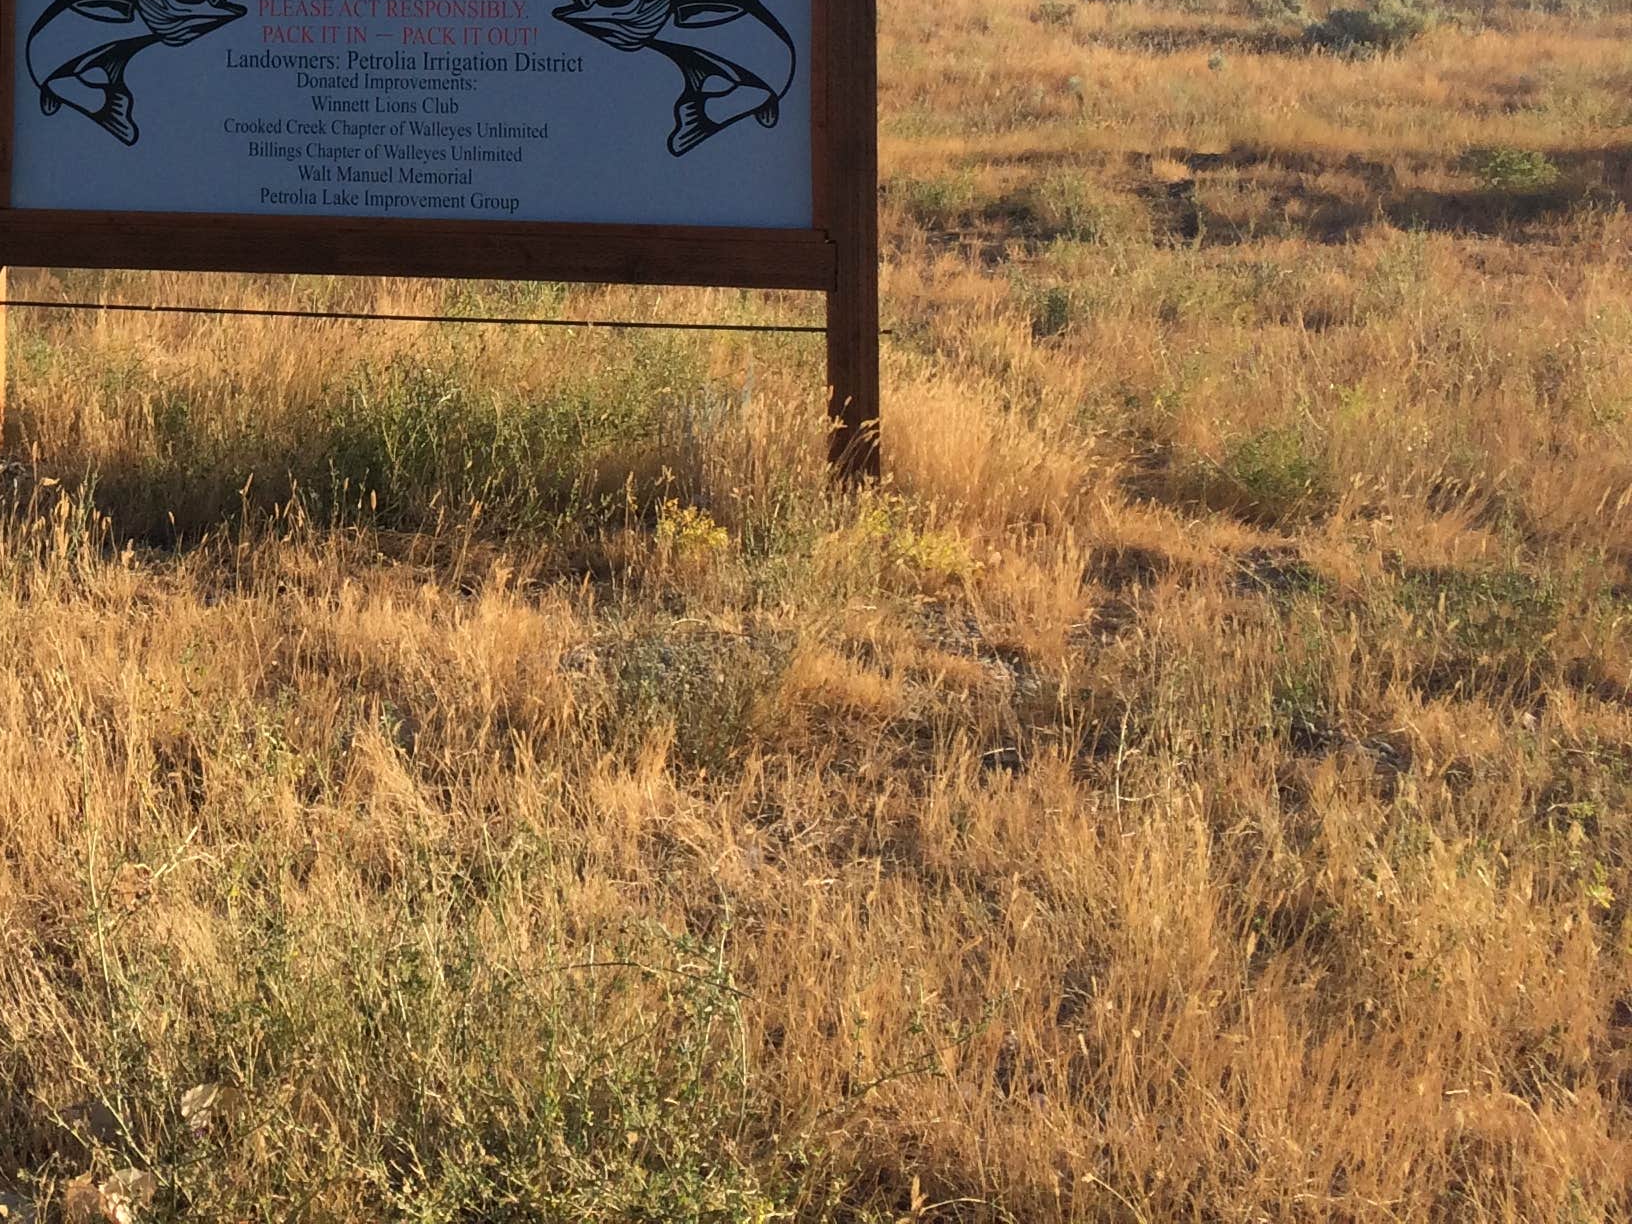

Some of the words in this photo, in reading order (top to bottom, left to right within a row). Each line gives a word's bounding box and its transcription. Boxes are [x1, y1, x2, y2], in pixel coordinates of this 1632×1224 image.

[258, 0, 333, 17] PLEASE
[339, 0, 382, 17] ACT
[386, 0, 528, 19] RESPONSIBLY.
[262, 25, 314, 43] PACK
[322, 25, 341, 44] IT
[346, 26, 367, 44] IN
[402, 27, 456, 45] PACK
[463, 27, 483, 45] IT
[488, 28, 538, 46] OUT!
[227, 49, 340, 69] Landowners:
[348, 51, 416, 70] Petrolia
[424, 51, 508, 76] Irrigation
[515, 53, 583, 72] District
[297, 73, 358, 89] Donated
[364, 73, 477, 93] Improvements:
[312, 96, 369, 112] Winnett
[375, 97, 416, 113] Lions
[422, 98, 458, 114] Club
[223, 118, 282, 133] Crooked
[286, 119, 327, 134] Creek
[331, 120, 385, 139] Chapter
[390, 121, 405, 135] of
[409, 121, 472, 140] Walleyes
[477, 123, 548, 139] Unlimited
[248, 142, 302, 160] Billings
[306, 143, 360, 162] Chapter
[364, 144, 381, 159] of
[383, 144, 446, 164] Walleyes
[451, 146, 522, 162] Unlimited
[298, 166, 332, 182] Walt
[337, 166, 393, 183] Manuel
[399, 168, 472, 185] Memorial
[260, 188, 317, 205] Petrolia
[322, 189, 359, 205] Lake
[364, 190, 465, 211] Improvement
[471, 192, 519, 213] Group
